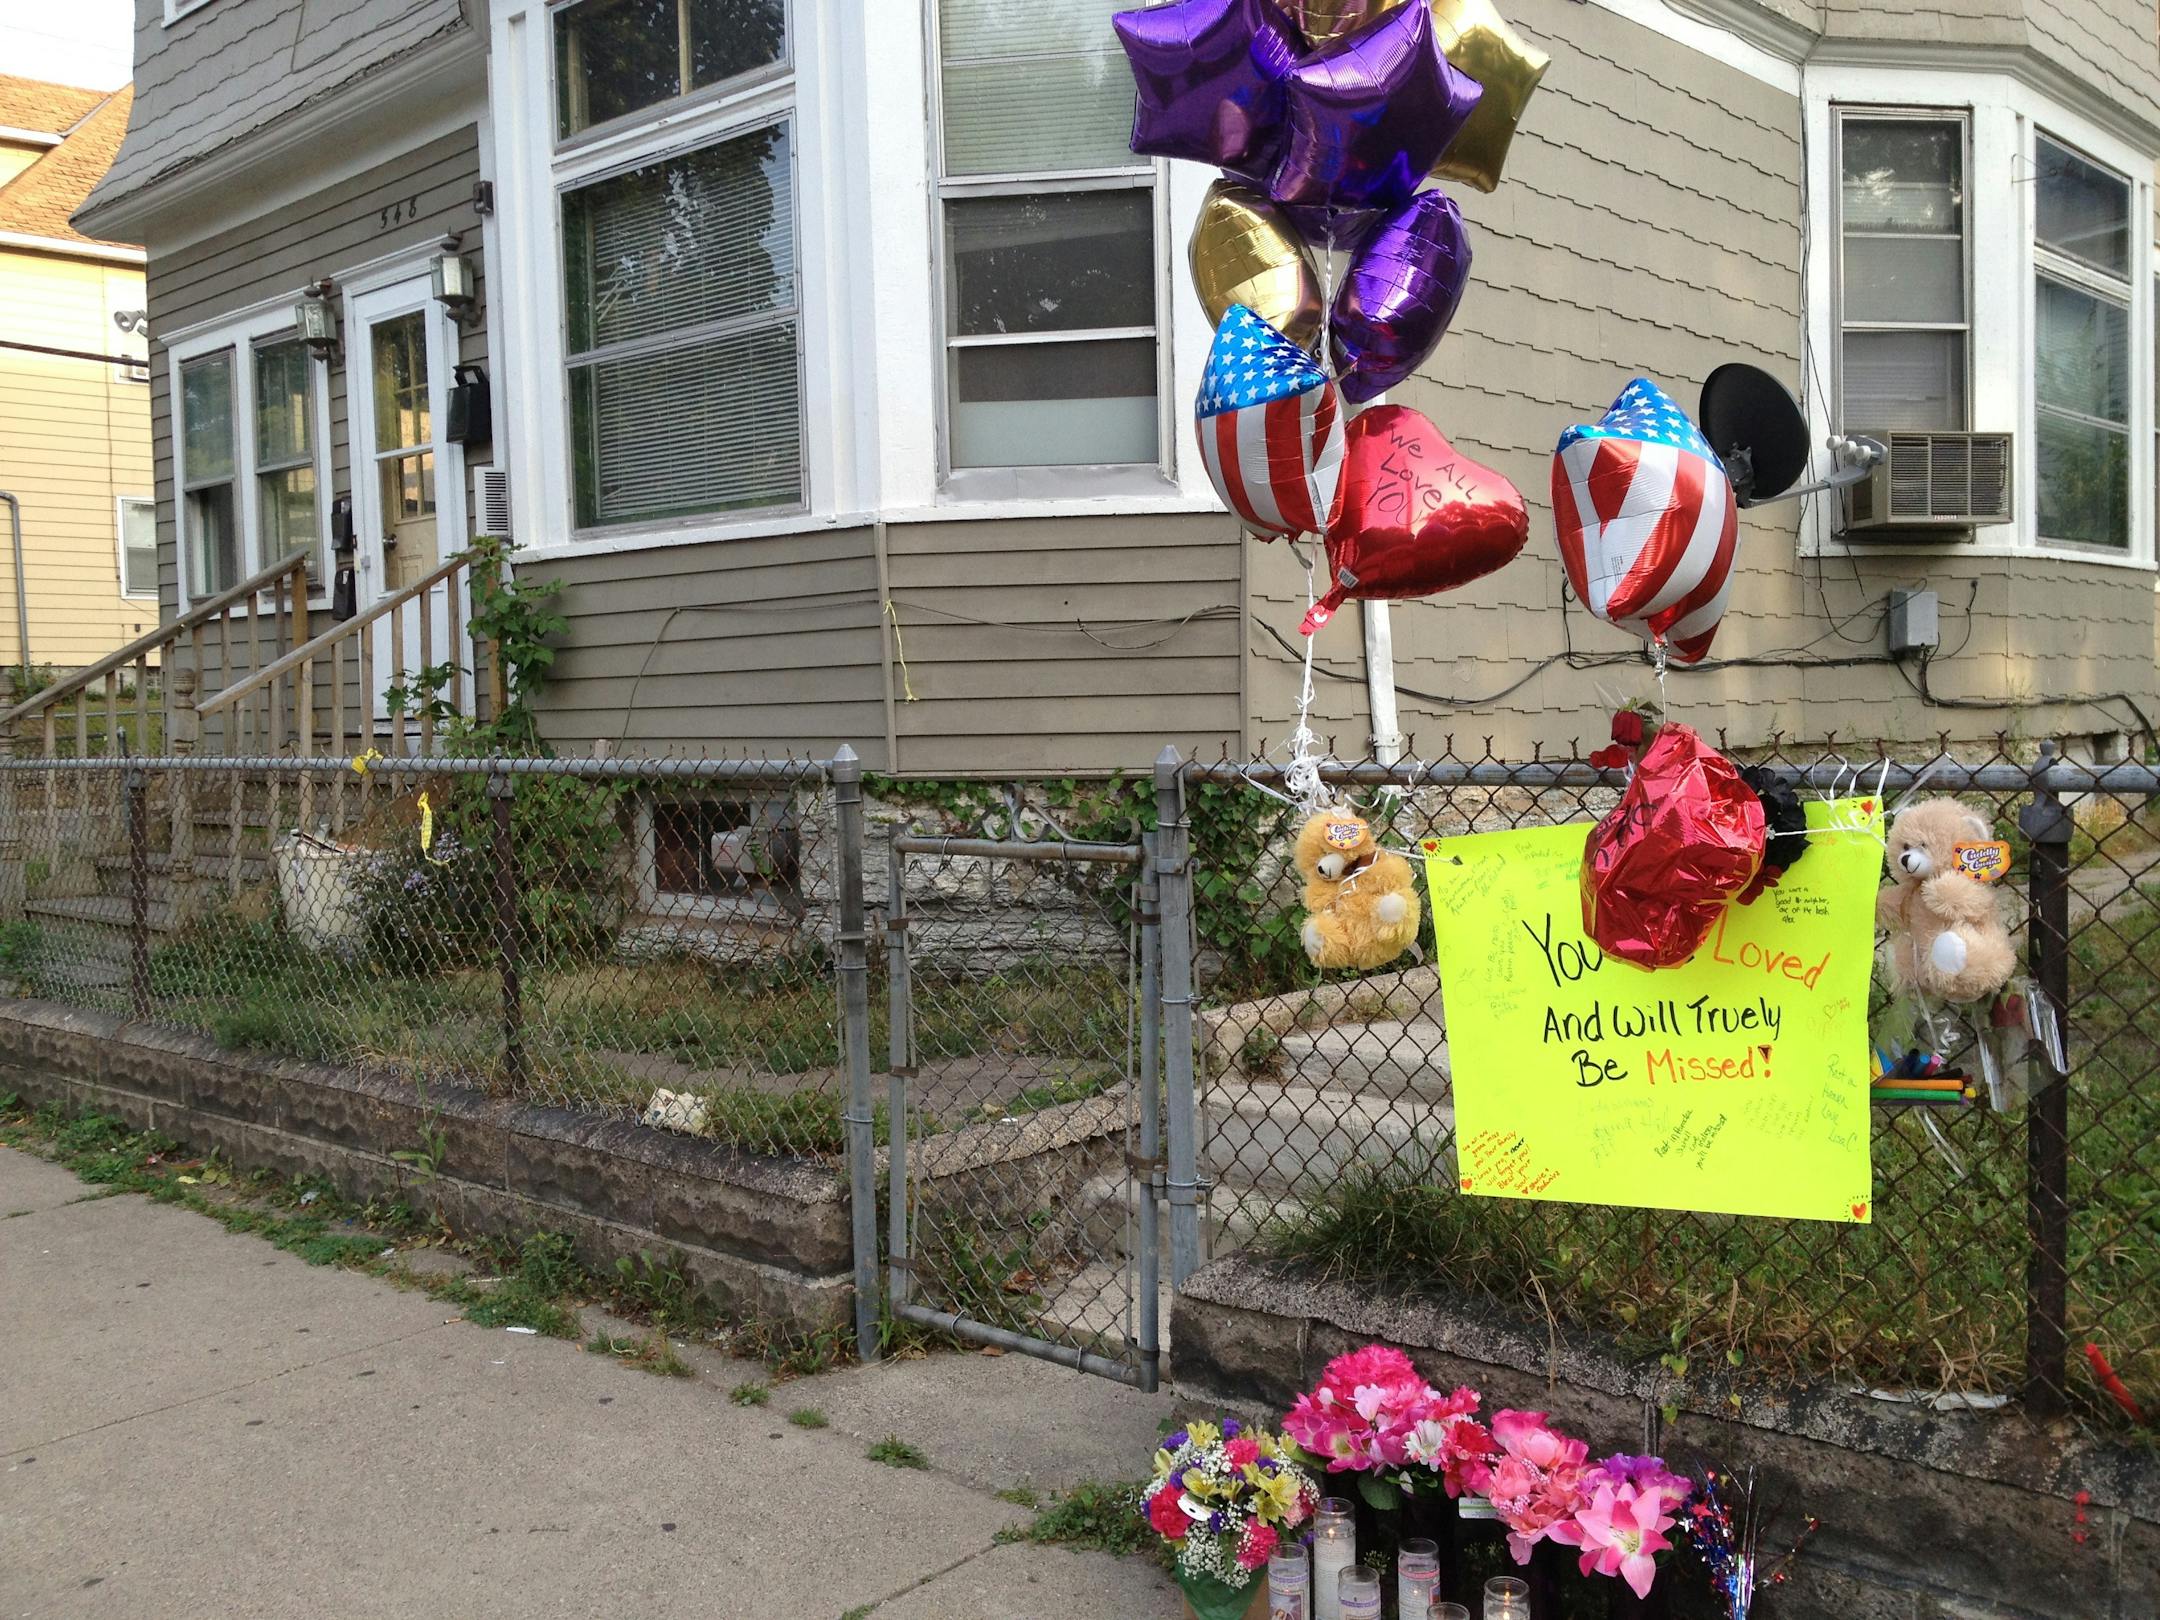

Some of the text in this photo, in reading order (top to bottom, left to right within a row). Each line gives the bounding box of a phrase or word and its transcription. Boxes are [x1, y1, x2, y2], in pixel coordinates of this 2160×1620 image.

[1381, 452, 1442, 510] Love
[1390, 423, 1478, 500] We ALL
[1960, 846, 1999, 864] Cuddly
[1714, 904, 1831, 991] Loved
[1543, 1000, 1604, 1043] And
[1686, 994, 1781, 1041] Truely
[1571, 1044, 1774, 1087] Be Missed!
